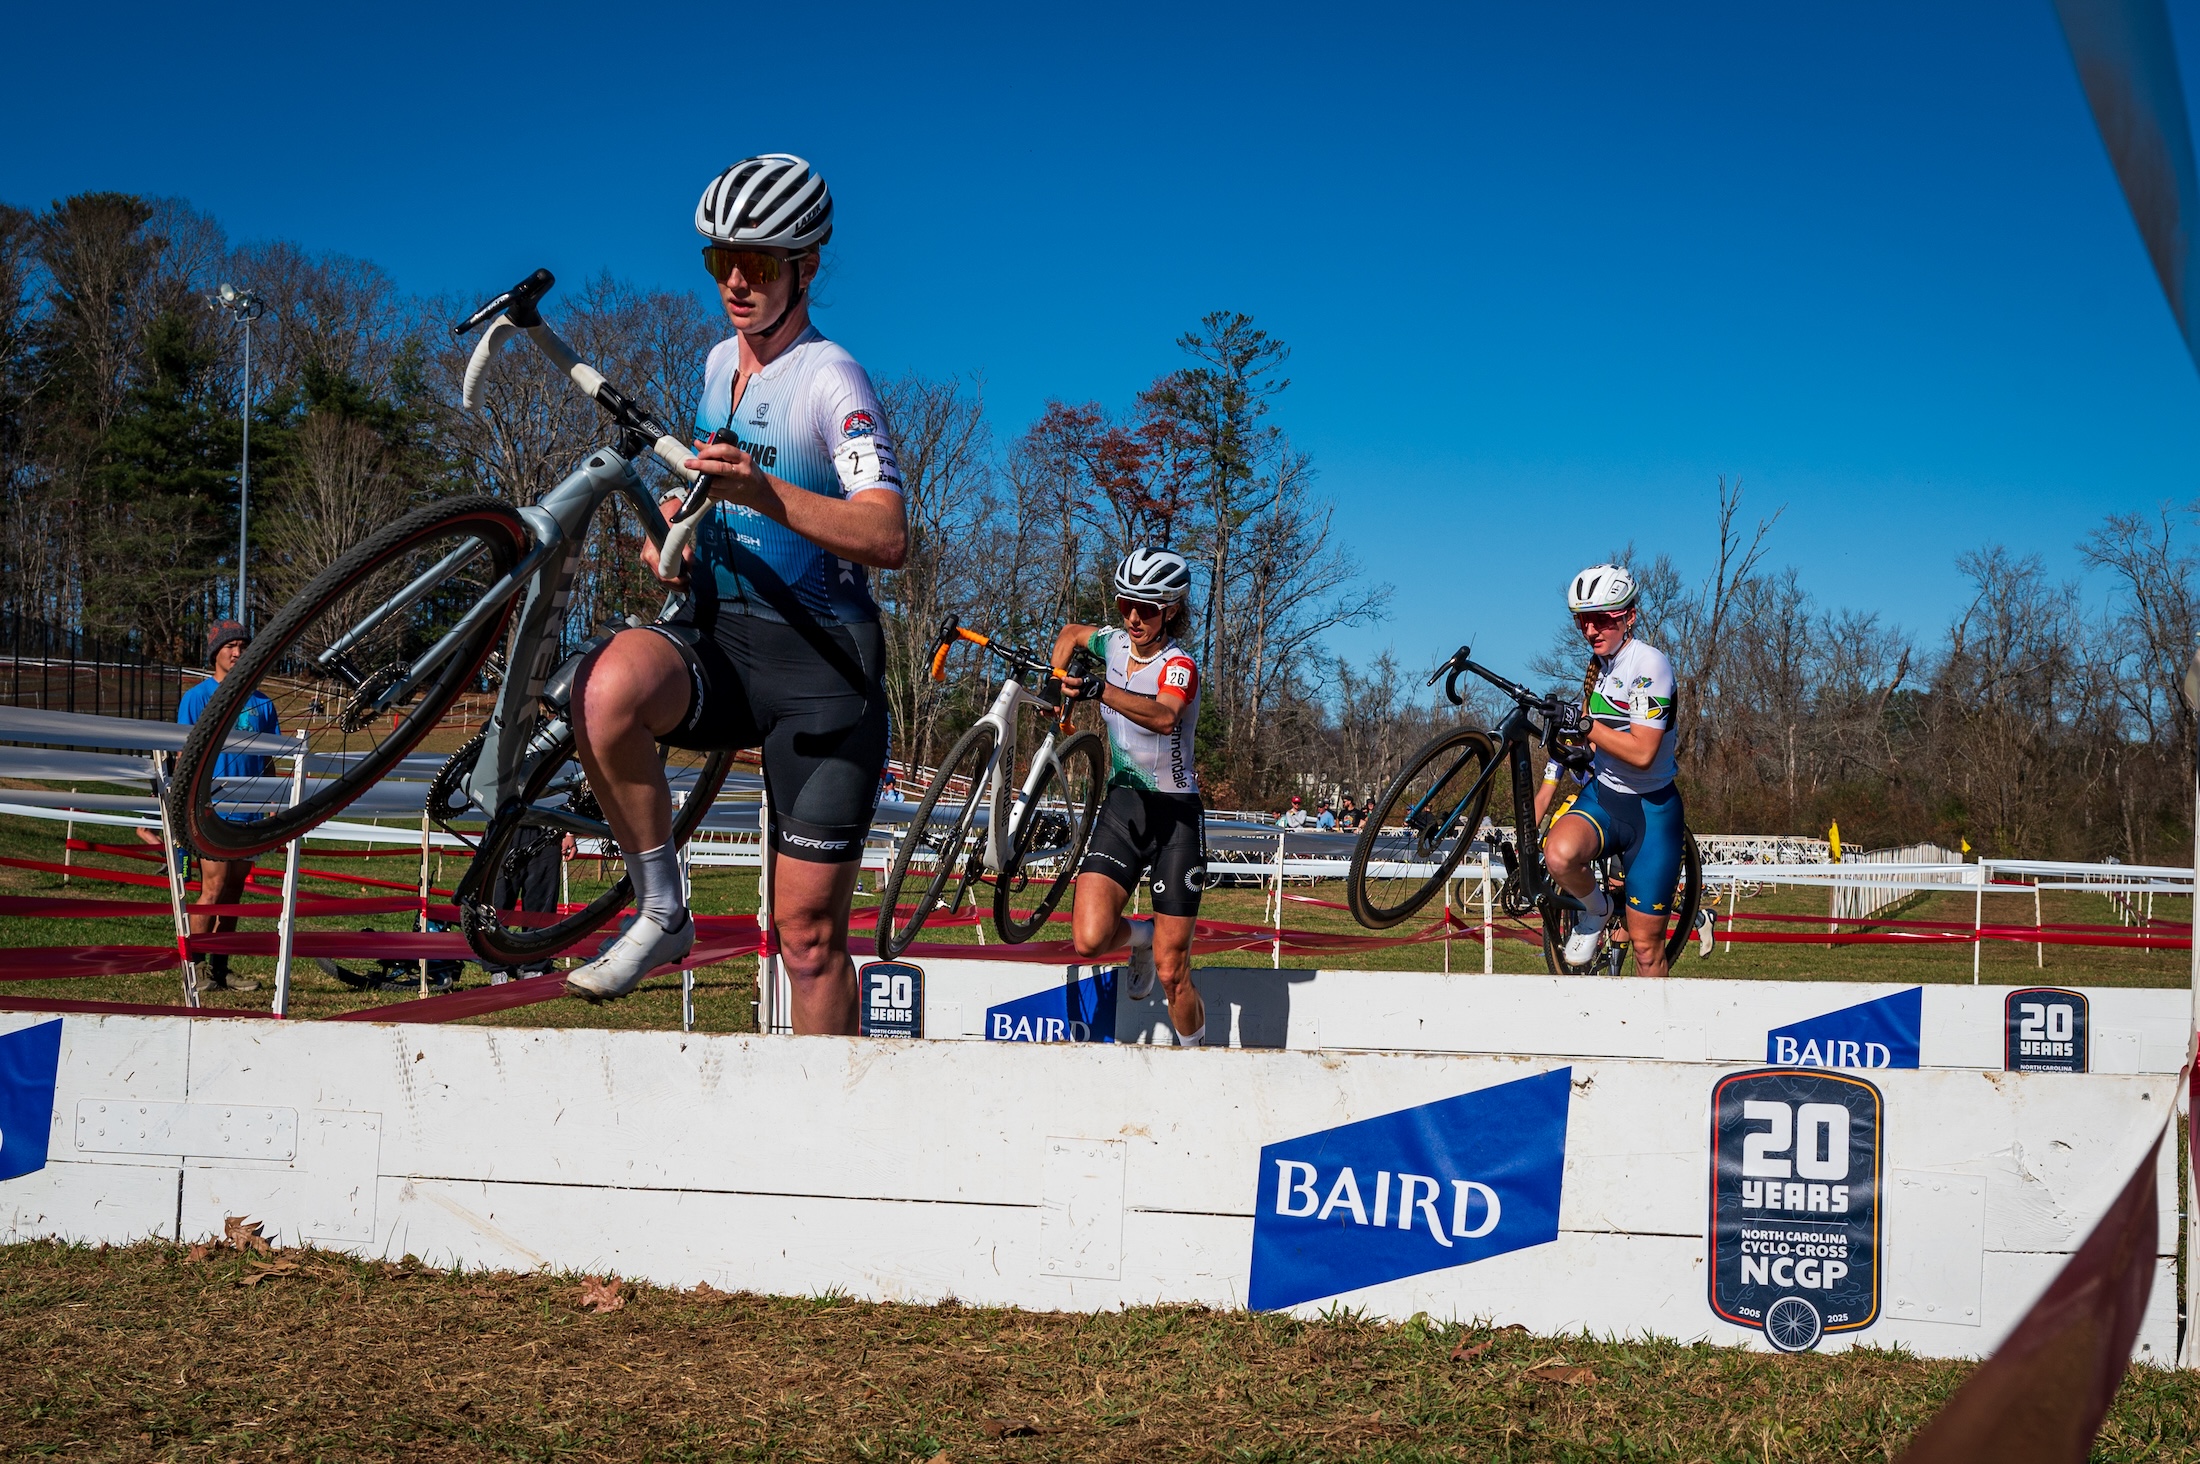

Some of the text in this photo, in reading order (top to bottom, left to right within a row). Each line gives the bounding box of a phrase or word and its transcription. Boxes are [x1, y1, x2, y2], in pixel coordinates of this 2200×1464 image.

[848, 451, 863, 475] 2
[1169, 672, 1185, 686] 26
[1001, 745, 1014, 828] cannondale
[1519, 760, 1536, 855] cannondale
[782, 831, 849, 850] VERGE
[870, 974, 912, 1009] 20
[870, 1009, 912, 1023] YEARS
[993, 1013, 1091, 1043] BAIRD
[2020, 1003, 2073, 1041] 20
[1775, 1036, 1890, 1068] BAIRD
[2020, 1041, 2073, 1057] YEARS
[1742, 1100, 1849, 1181] 20
[1275, 1159, 1501, 1248] BAIRD
[1742, 1180, 1849, 1213] YEARS
[1740, 1242, 1848, 1259] CYCLO-CROSS
[1741, 1229, 1848, 1245] NORTH CAROLINA
[1740, 1256, 1848, 1290] NCGP
[1738, 1306, 1761, 1319] 2005
[1827, 1313, 1849, 1323] 2025
